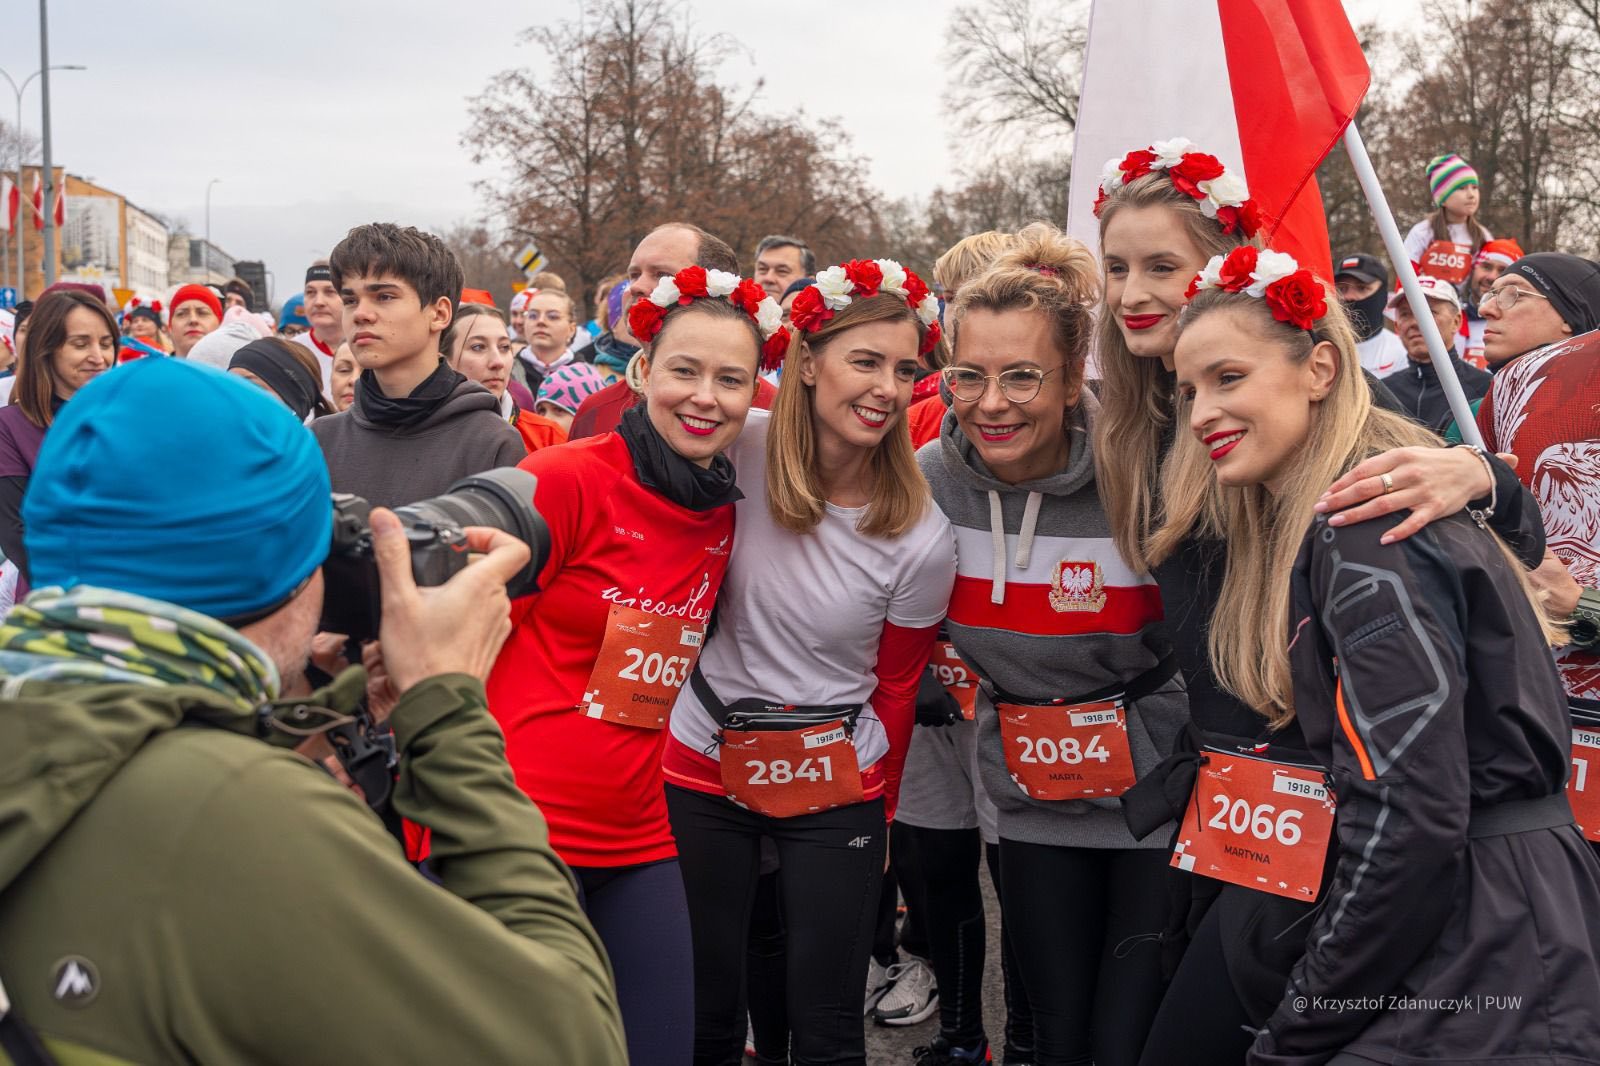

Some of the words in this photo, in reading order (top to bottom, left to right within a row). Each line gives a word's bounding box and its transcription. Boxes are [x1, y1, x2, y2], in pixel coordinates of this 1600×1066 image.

[1427, 251, 1465, 269] 2505
[618, 647, 690, 688] 2063
[1083, 714, 1103, 723] 1918
[816, 733, 834, 745] 1918
[836, 731, 843, 739] m
[1016, 735, 1110, 764] 2084
[745, 756, 833, 785] 2841
[1049, 773, 1084, 781] MARTA
[1287, 781, 1311, 794] 1918
[1313, 787, 1325, 798] m
[1208, 794, 1304, 846] 2066
[1223, 845, 1271, 864] MARTYNA
